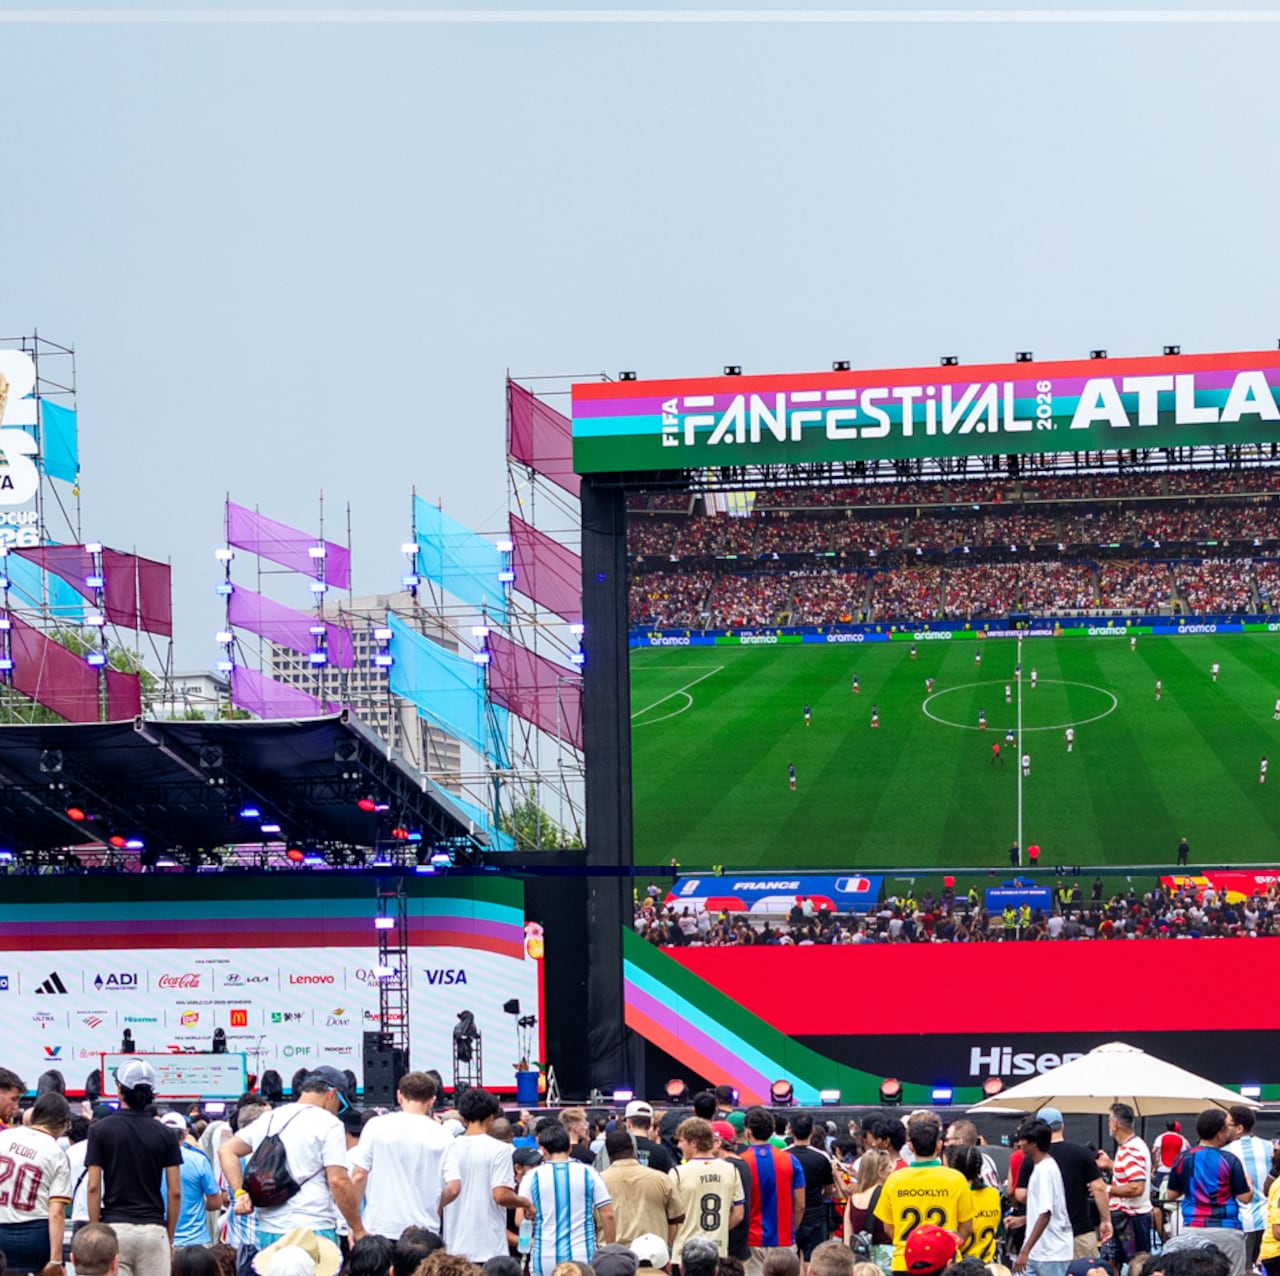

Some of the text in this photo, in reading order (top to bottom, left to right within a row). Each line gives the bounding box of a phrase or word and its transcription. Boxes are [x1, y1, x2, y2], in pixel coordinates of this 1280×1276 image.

[662, 398, 679, 447] FIFA
[1036, 380, 1052, 431] 2026
[1088, 627, 1127, 636] aramco
[1178, 624, 1217, 633] aramco
[740, 634, 778, 644] aramco
[827, 633, 864, 643] aramco
[914, 631, 952, 640] aramco
[650, 636, 690, 646] aramco
[733, 880, 800, 890] FRANCE
[106, 973, 138, 985] ADI
[289, 974, 335, 984] Lenovo
[423, 969, 467, 985] VISA
[326, 1015, 350, 1026] Dove
[295, 1047, 311, 1055] PIF
[8, 1142, 38, 1160] PEDRI
[700, 1174, 721, 1184] PEDRI
[700, 1192, 721, 1232] 8
